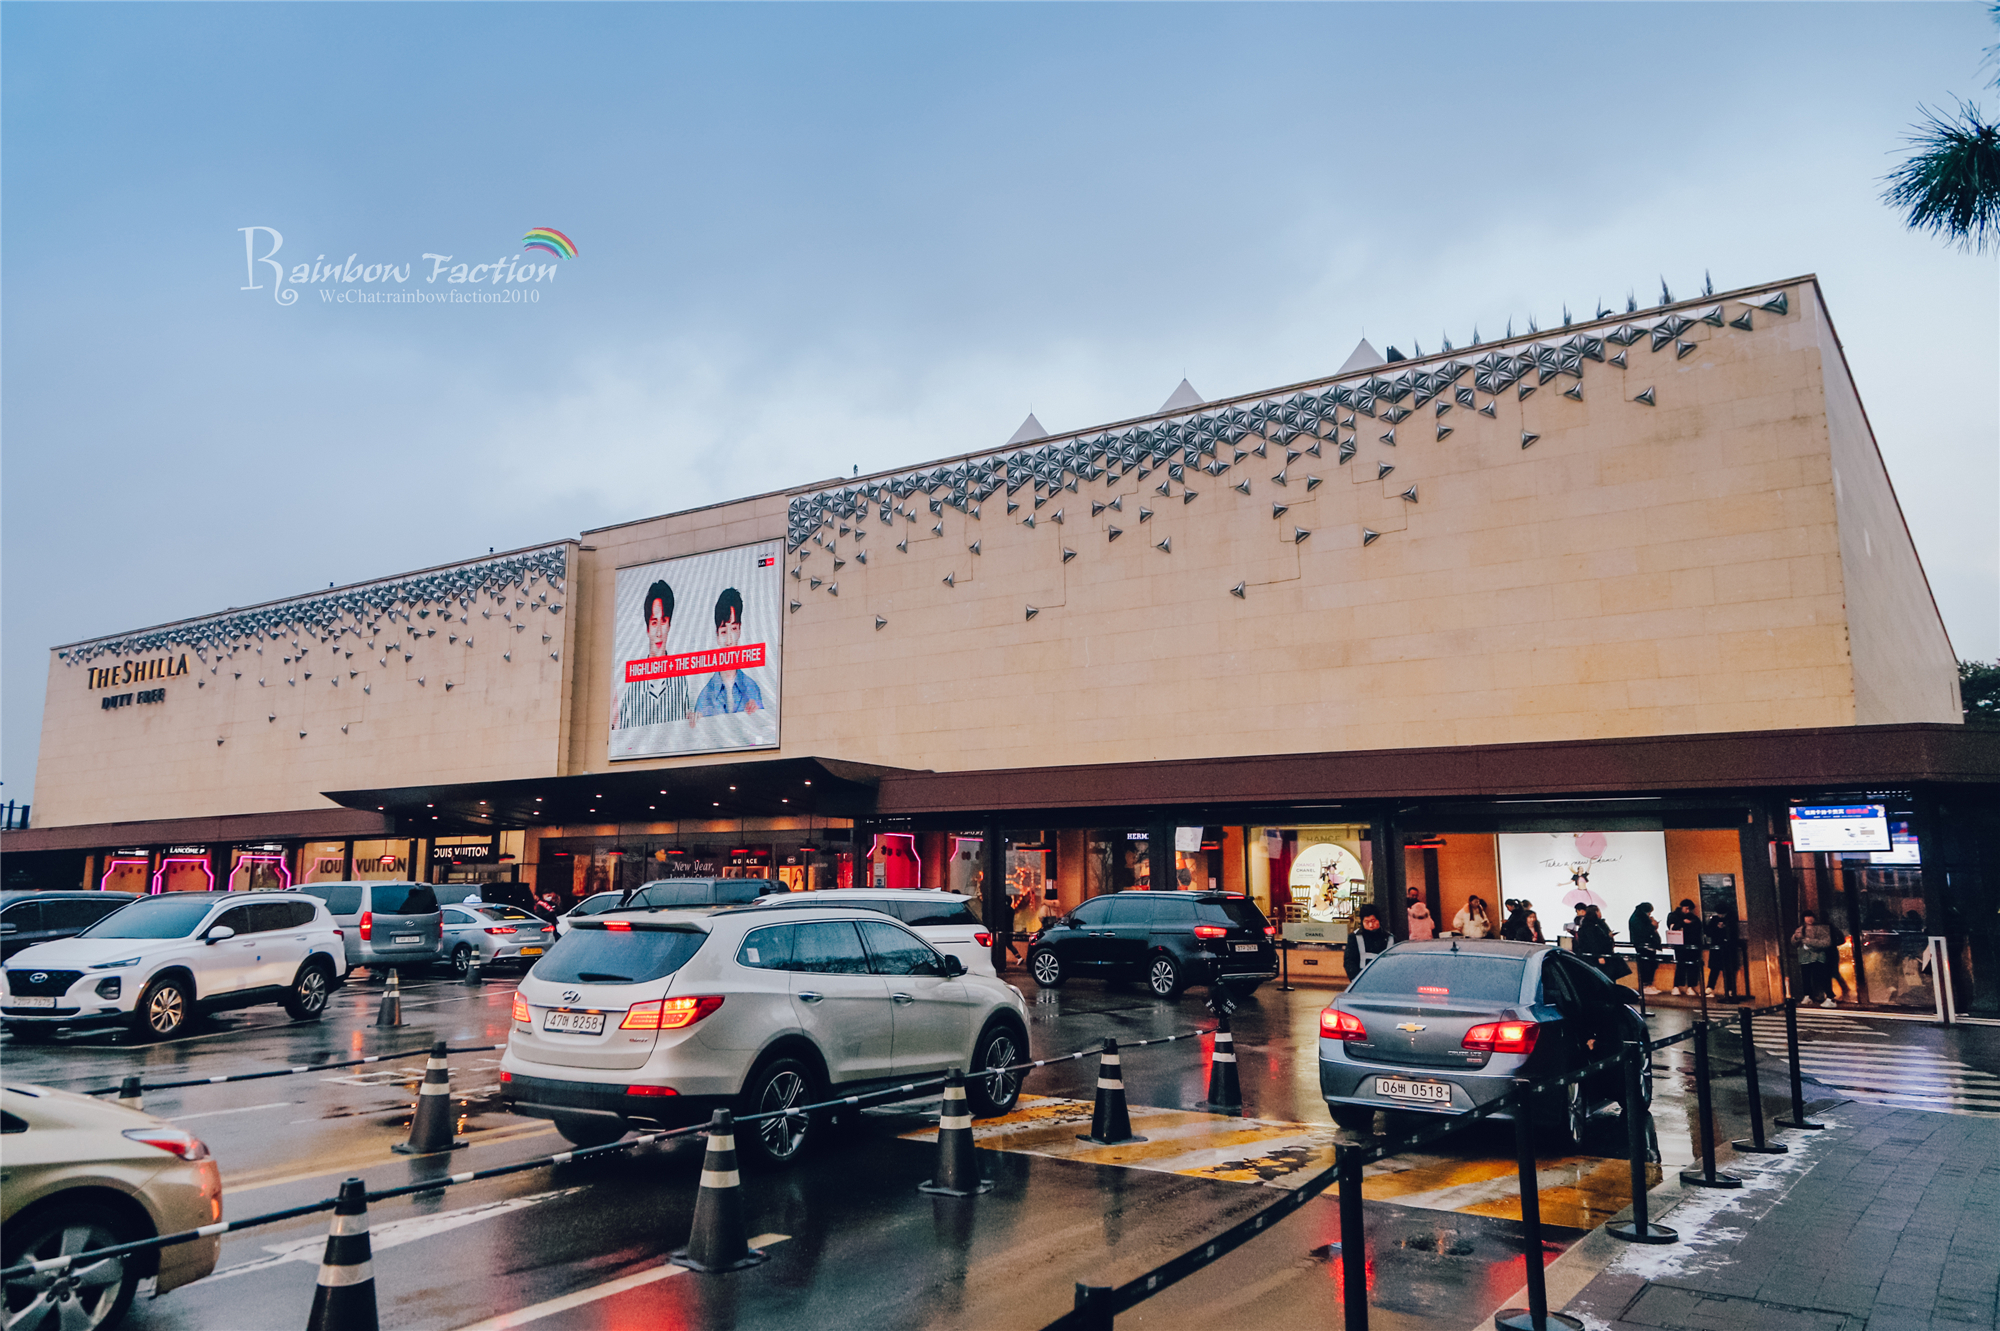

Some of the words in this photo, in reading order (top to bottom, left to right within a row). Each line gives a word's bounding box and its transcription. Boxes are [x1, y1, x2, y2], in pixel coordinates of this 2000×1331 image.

[629, 660, 668, 677] HIGHLIGHT
[675, 658, 690, 671] THE
[691, 653, 717, 669] SHILLA
[719, 650, 740, 665] DUTY
[742, 647, 762, 661] FREE
[101, 693, 134, 710] DUTY
[137, 688, 165, 704] FREE
[673, 861, 691, 871] New
[573, 1015, 598, 1029] 8258
[1383, 1081, 1405, 1094] 06버
[1412, 1084, 1443, 1098] 0518
